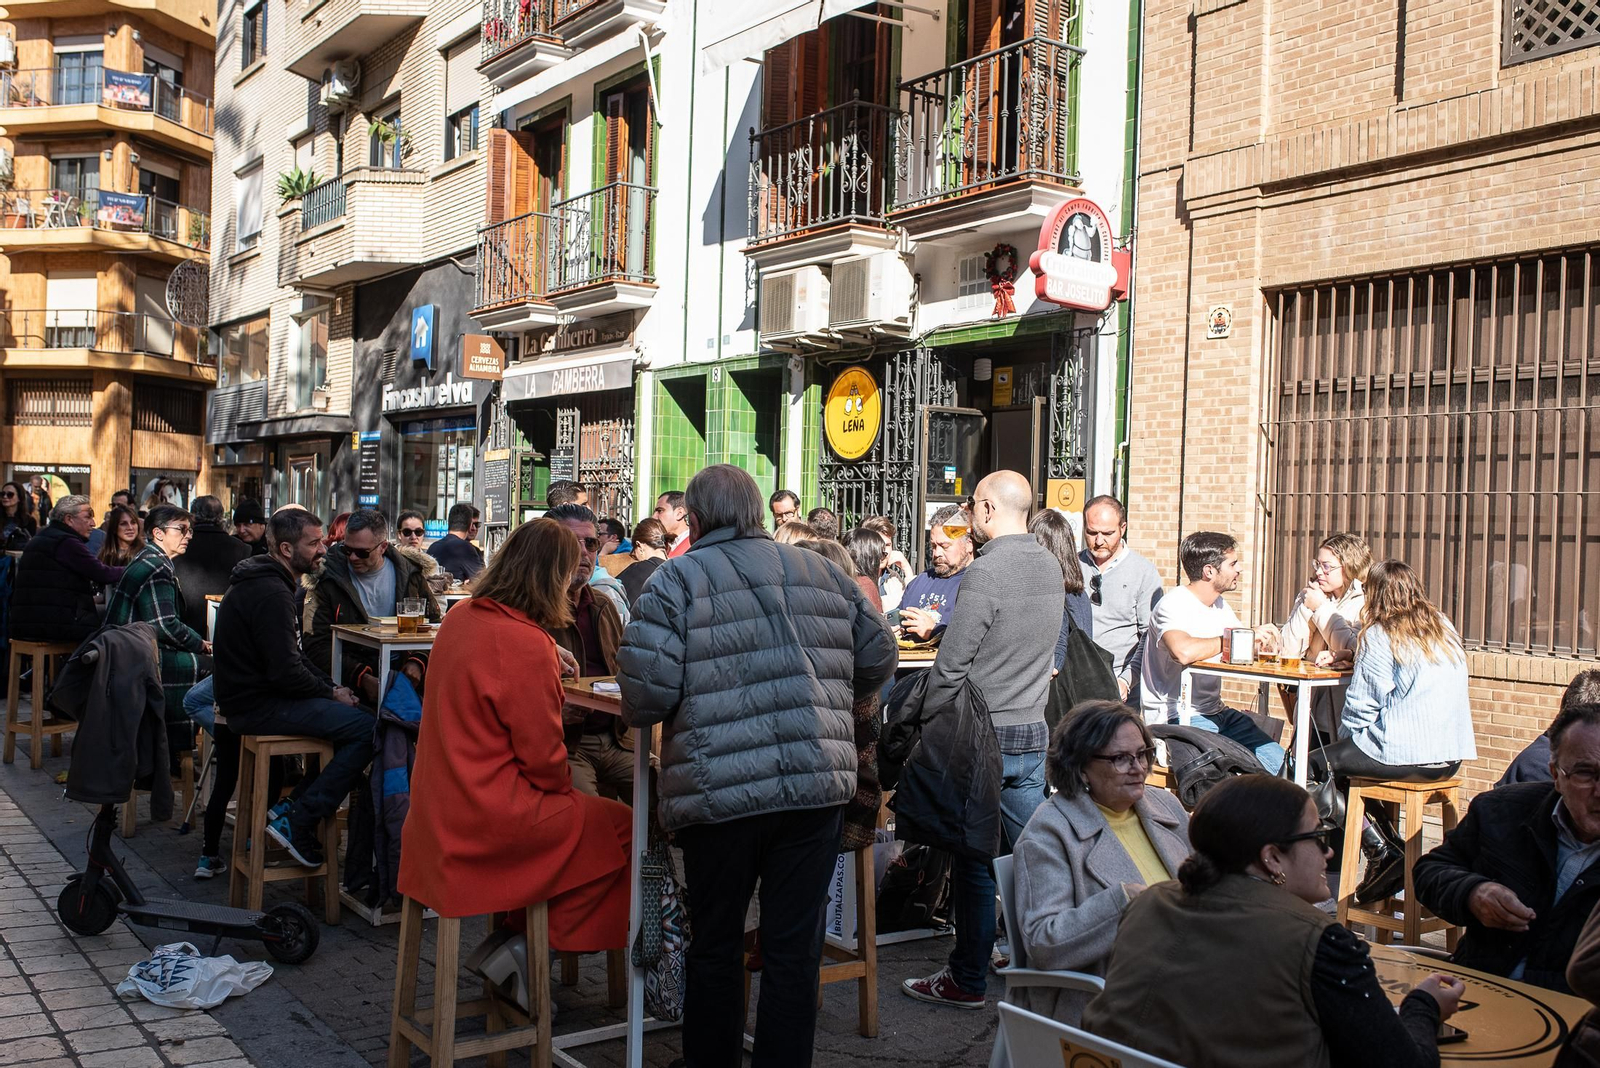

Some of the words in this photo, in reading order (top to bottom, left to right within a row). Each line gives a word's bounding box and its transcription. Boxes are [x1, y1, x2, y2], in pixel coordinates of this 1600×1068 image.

[1065, 203, 1080, 214] CAMPO
[1047, 278, 1063, 296] BAR
[1066, 283, 1105, 305] JOSELITO
[525, 336, 538, 355] La
[469, 363, 500, 374] ALHAMBRA
[471, 355, 499, 365] CERVEZAS
[525, 374, 536, 398] LA
[551, 364, 605, 394] GAMBERRA
[713, 367, 719, 382] 8
[382, 372, 473, 412] Fincashuelva
[842, 415, 865, 433] LEÑA
[59, 466, 91, 474] PRODUCTOS
[835, 852, 846, 932] BRUTALZAPAS.CO
